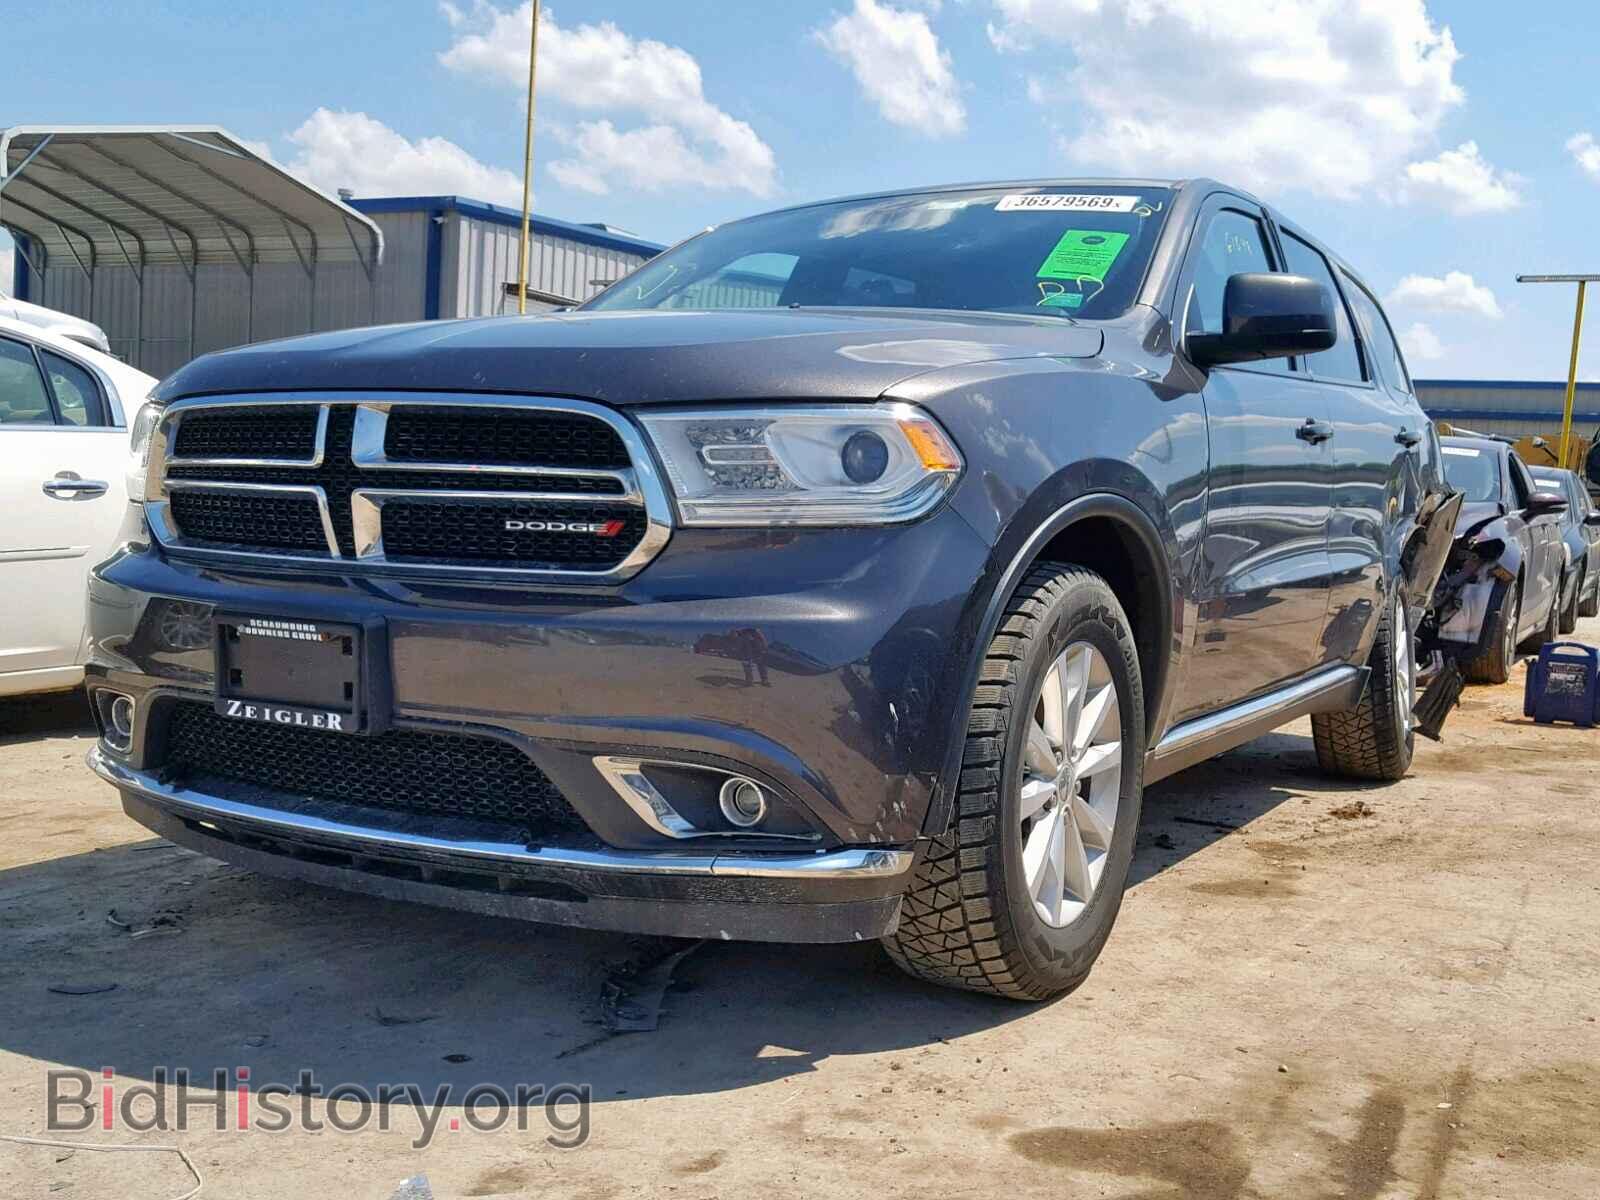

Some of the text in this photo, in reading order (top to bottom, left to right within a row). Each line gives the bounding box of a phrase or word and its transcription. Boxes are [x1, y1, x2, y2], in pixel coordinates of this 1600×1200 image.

[1014, 195, 1113, 208] 36579569
[505, 520, 608, 533] DODGE
[249, 618, 316, 632] SCHAUMBURG
[226, 699, 343, 731] ZEIGLER
